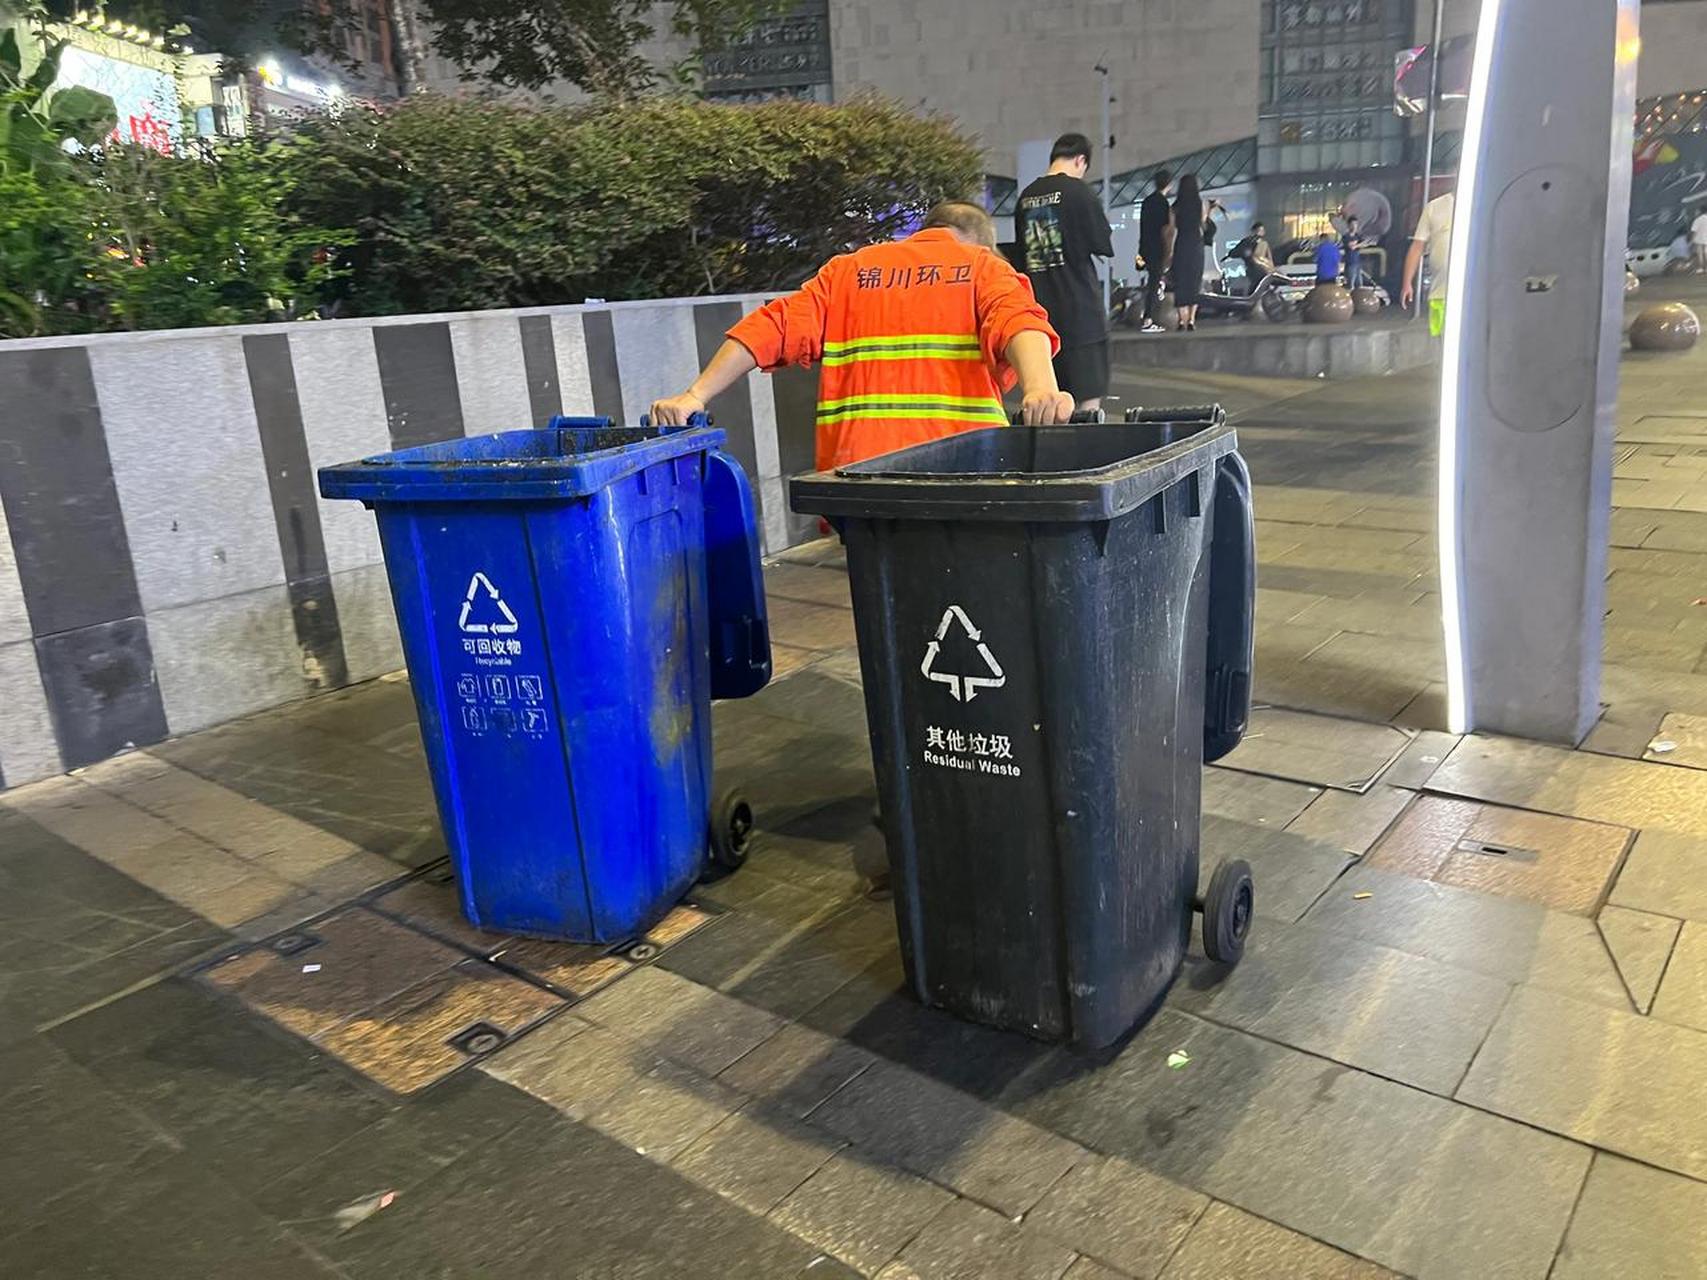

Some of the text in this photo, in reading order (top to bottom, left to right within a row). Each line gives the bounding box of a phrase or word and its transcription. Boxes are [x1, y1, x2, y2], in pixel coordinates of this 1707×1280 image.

[857, 264, 972, 289] 锦川环卫
[461, 638, 522, 655] 可回收物
[926, 725, 1013, 759] 其他垃圾
[924, 750, 1021, 776] Residual Waste
